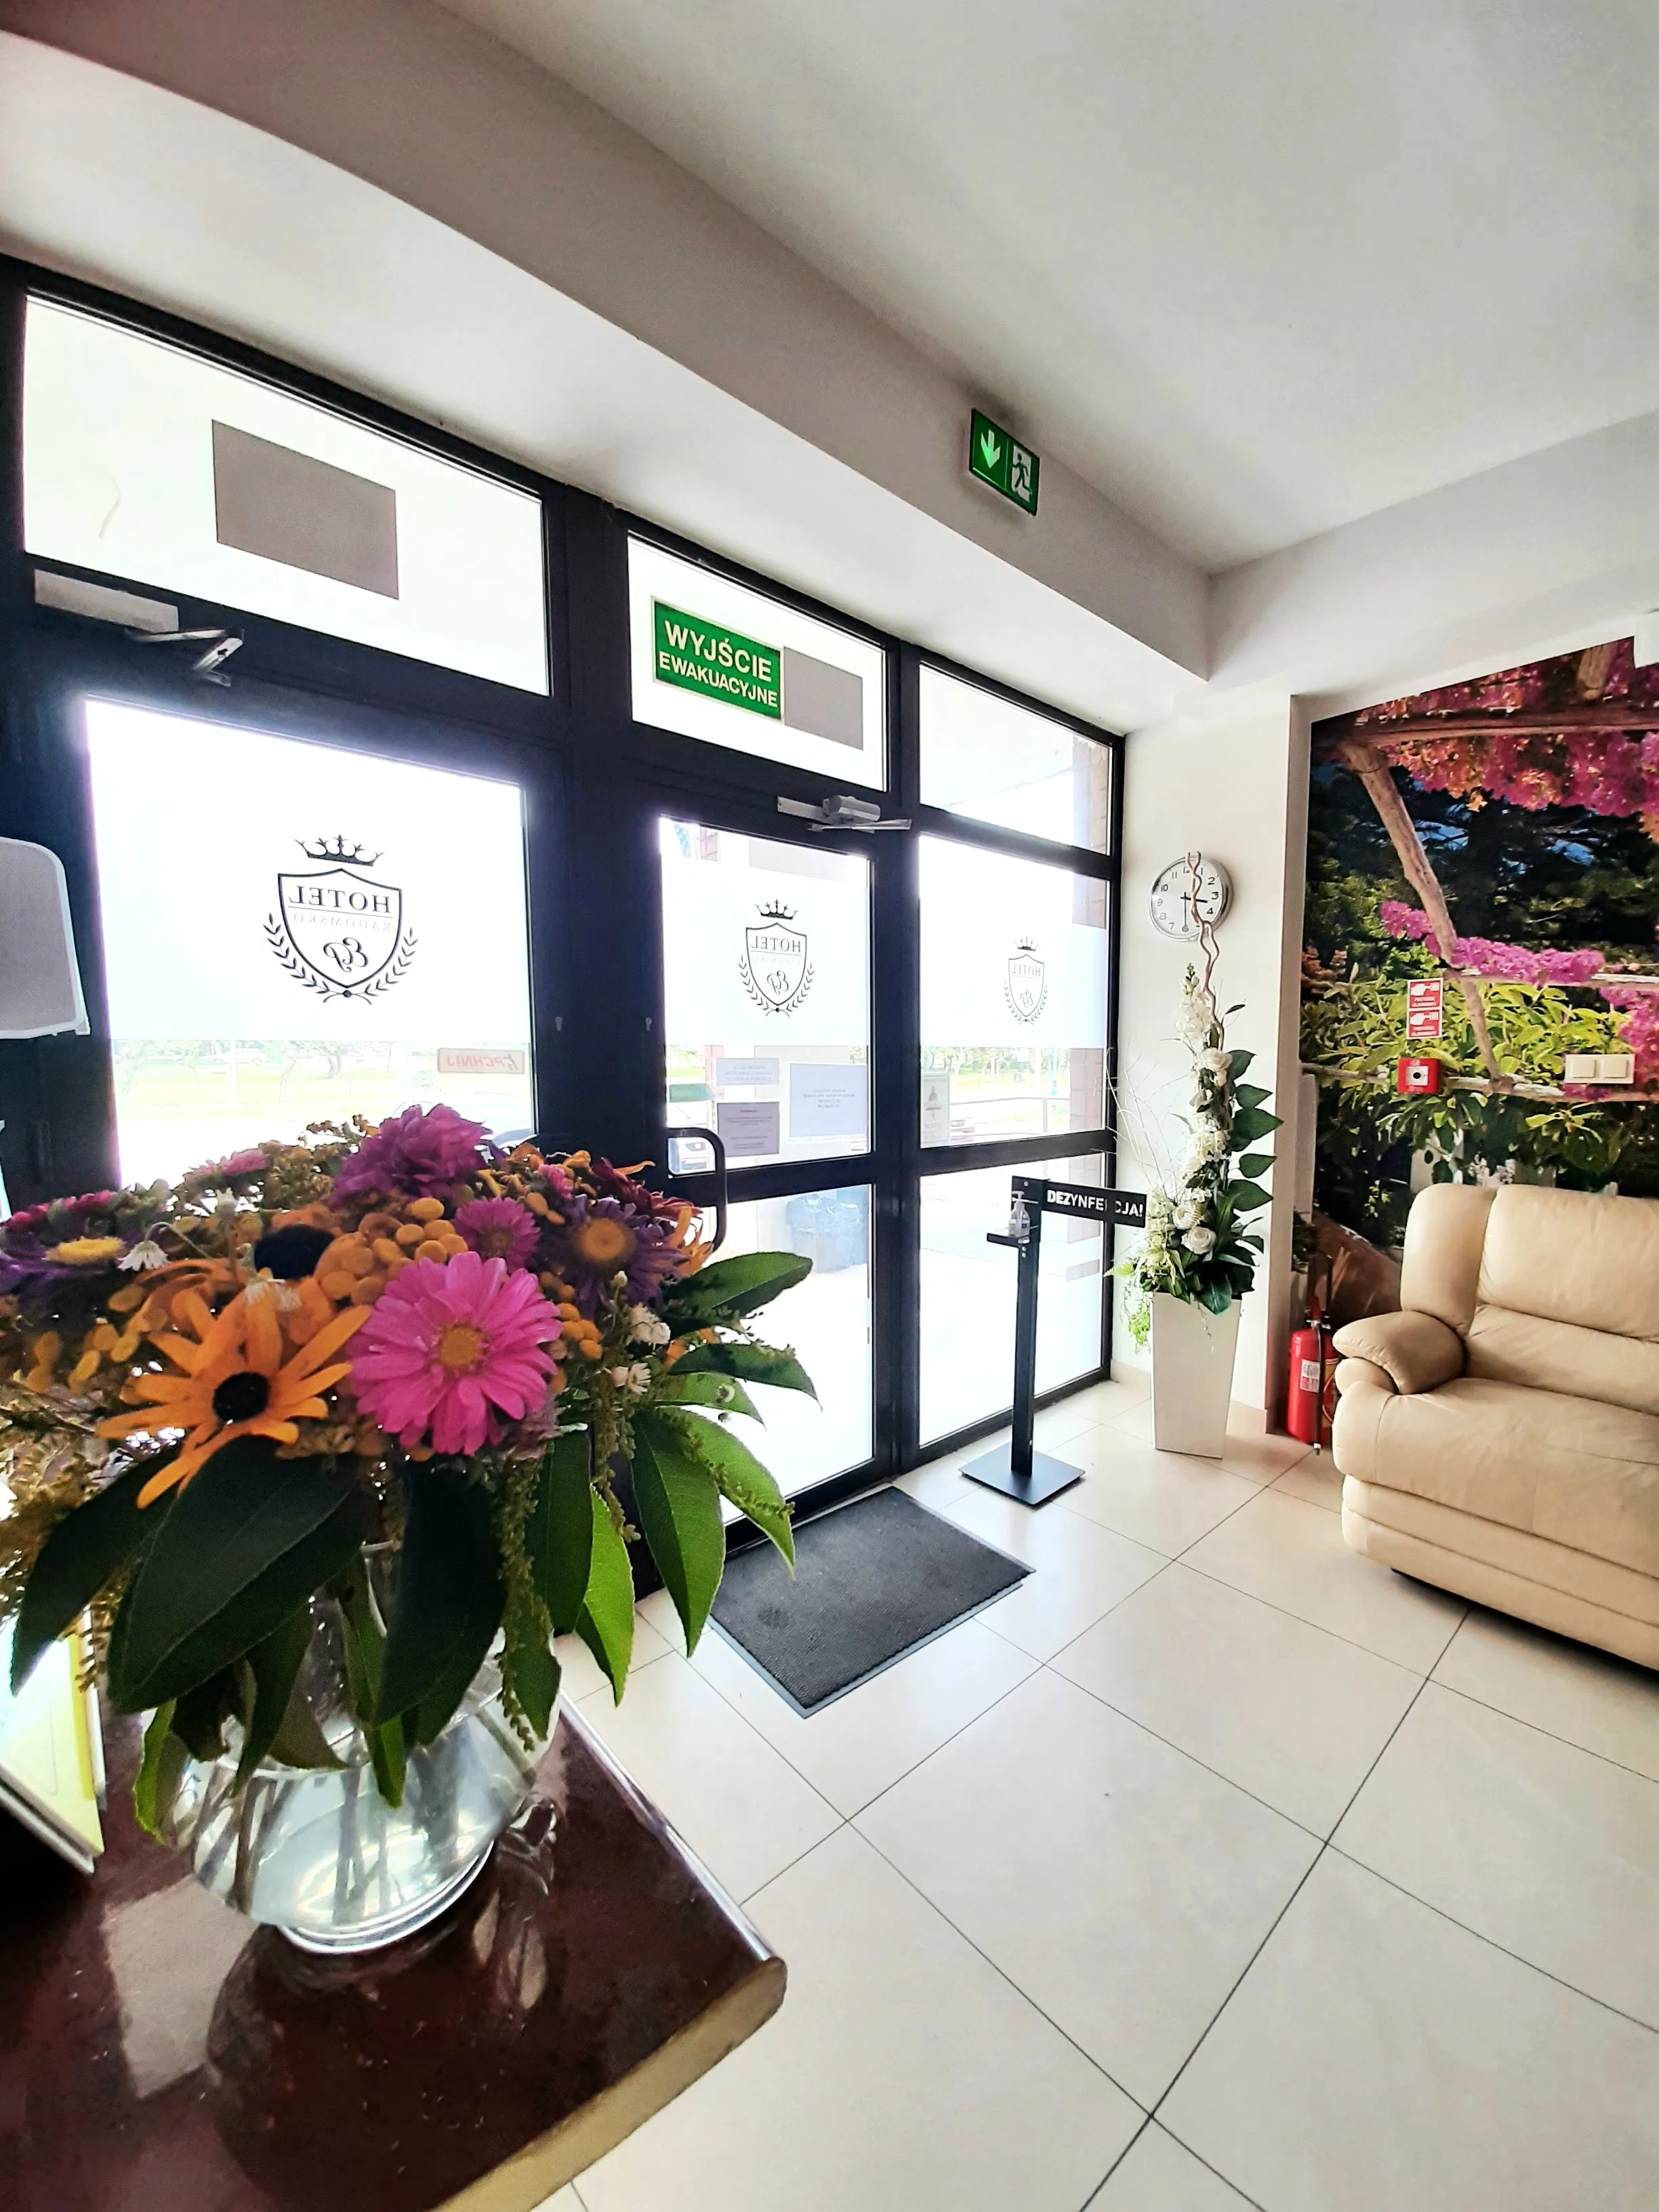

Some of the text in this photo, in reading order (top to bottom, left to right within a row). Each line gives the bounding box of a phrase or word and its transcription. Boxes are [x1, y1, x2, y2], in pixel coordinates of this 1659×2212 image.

[664, 619, 772, 682] WYJŚCIE
[659, 651, 778, 708] EWAKUACYJNE
[1172, 871, 1178, 879] 11
[1208, 877, 1215, 885] 2
[1161, 884, 1168, 892] 10
[1211, 891, 1219, 900] 3
[1159, 912, 1167, 920] 8
[1168, 922, 1175, 930] 7
